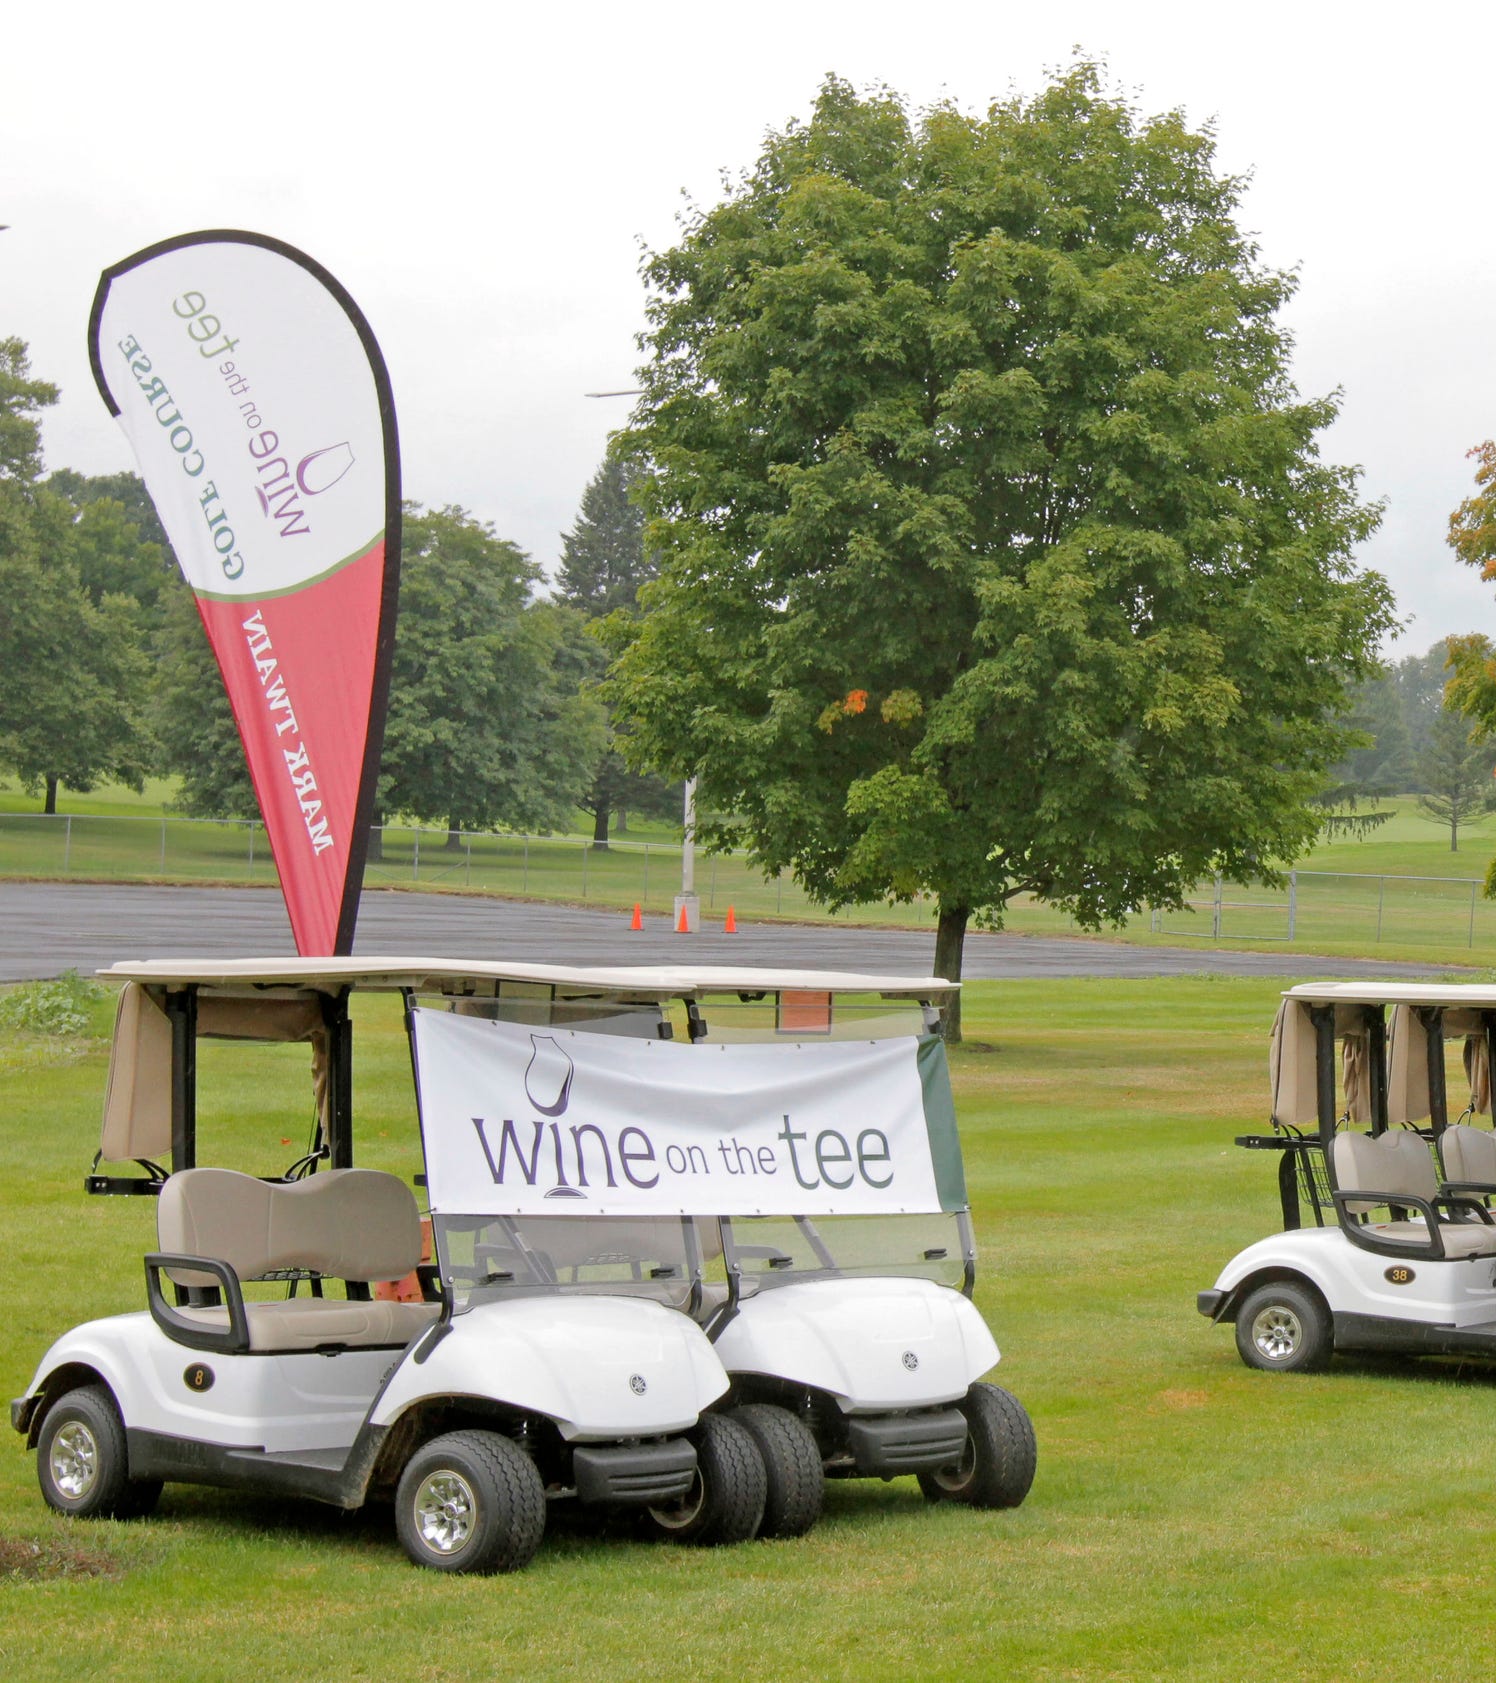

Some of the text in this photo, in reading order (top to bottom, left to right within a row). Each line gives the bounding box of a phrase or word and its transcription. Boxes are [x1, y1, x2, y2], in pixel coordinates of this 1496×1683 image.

[666, 1141, 710, 1175] on
[718, 1138, 777, 1176] the
[777, 1114, 895, 1190] tee
[1392, 1269, 1408, 1281] 38
[195, 1370, 204, 1386] 8
